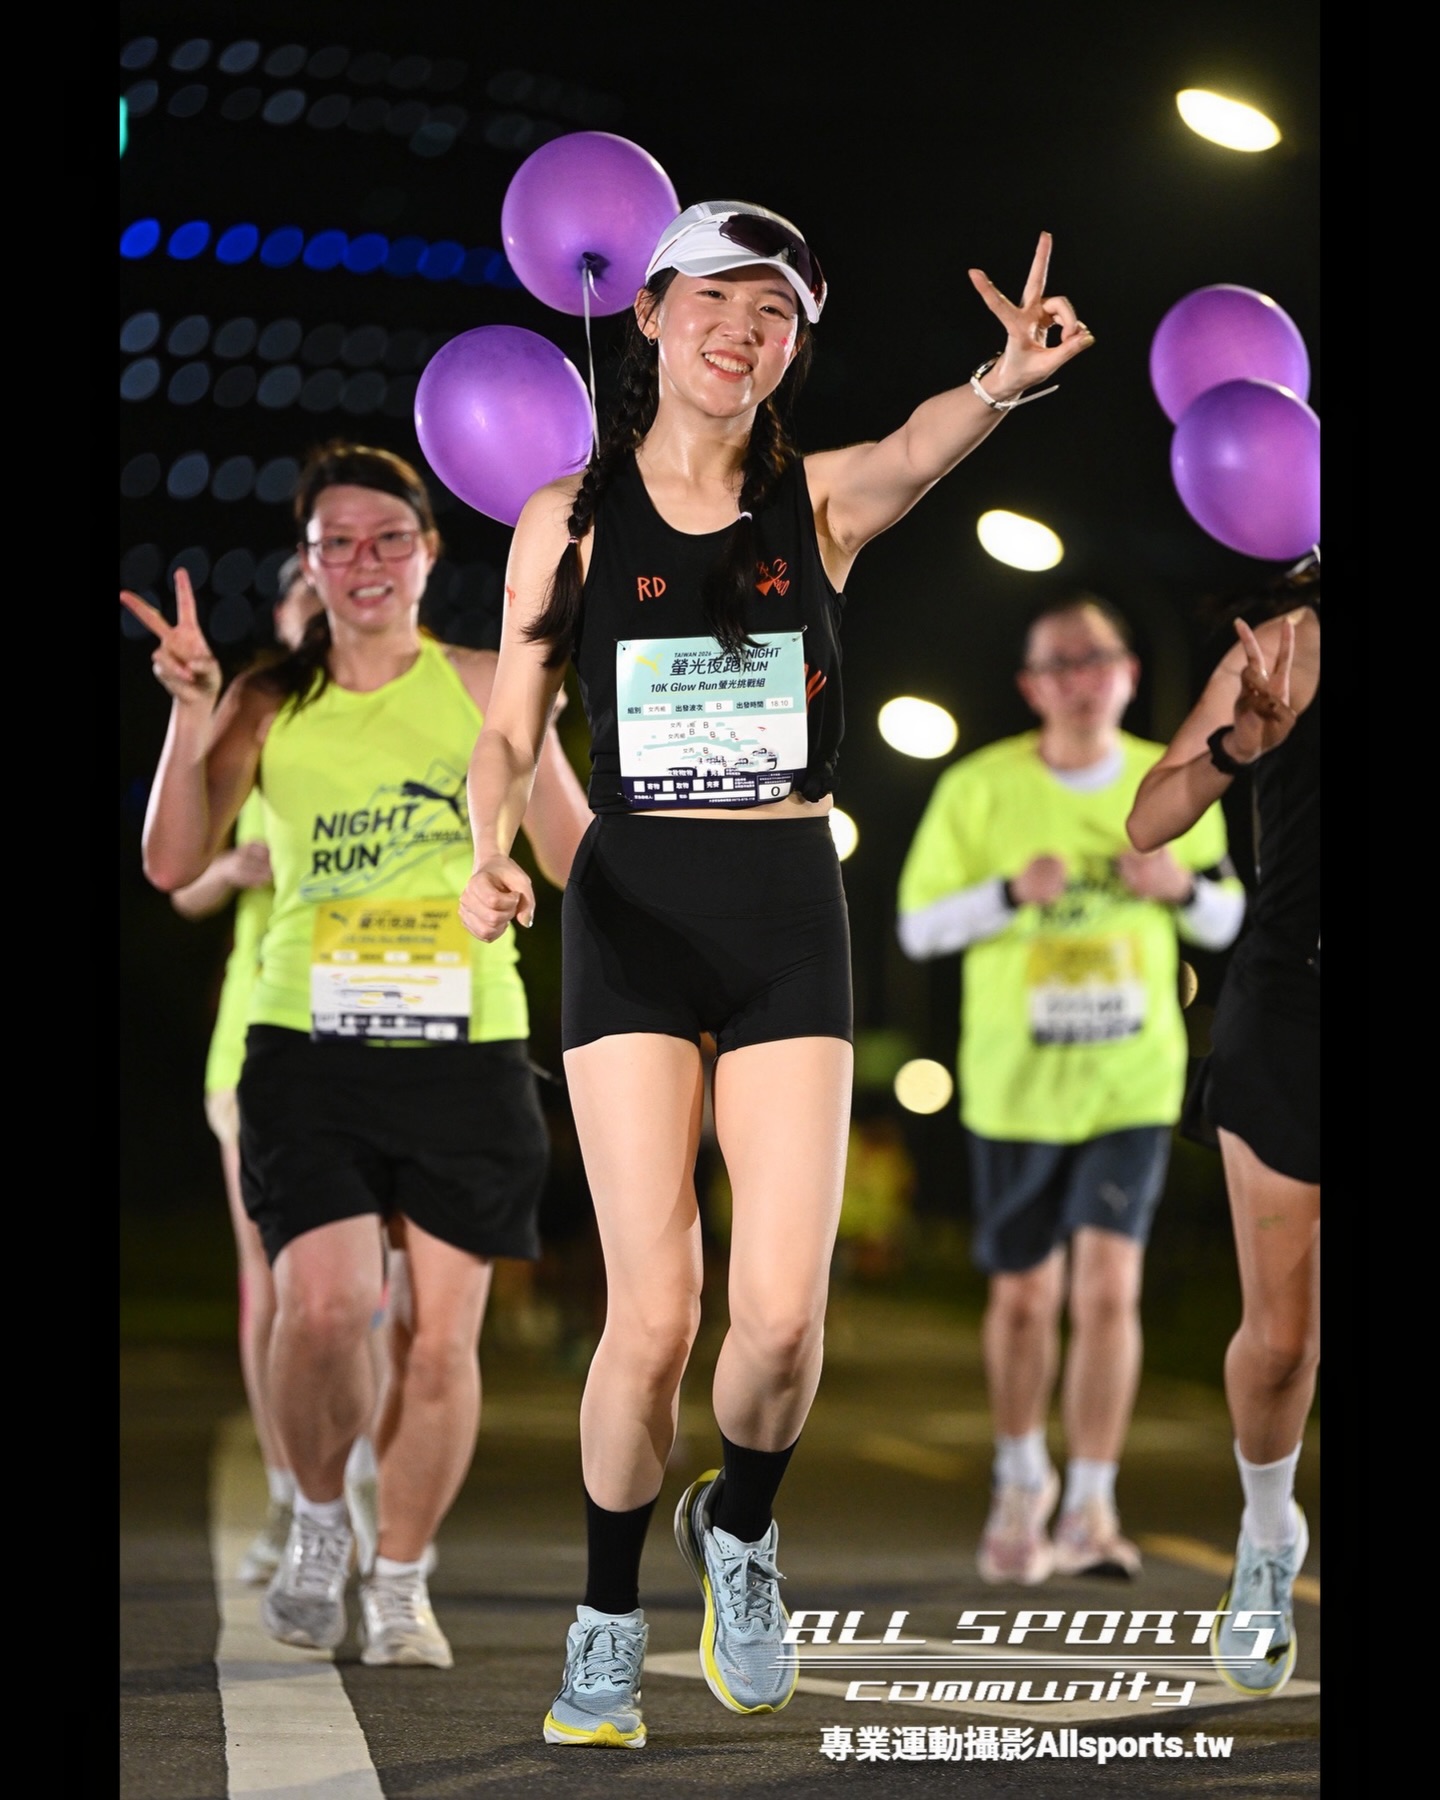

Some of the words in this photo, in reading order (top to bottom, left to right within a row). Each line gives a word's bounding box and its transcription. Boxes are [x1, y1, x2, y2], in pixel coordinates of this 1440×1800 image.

[637, 576, 667, 601] RD
[745, 647, 782, 659] NIGHT
[669, 657, 741, 677] 螢光夜跑
[743, 661, 768, 673] RUN
[650, 682, 668, 693] 10K
[670, 682, 697, 692] Glow
[675, 704, 704, 713] 出發波次
[715, 702, 722, 711] B
[736, 701, 765, 710] 出發時間
[703, 721, 709, 729] B
[689, 728, 695, 736] B
[730, 731, 737, 739] B
[312, 802, 420, 842] NIGHT
[311, 843, 381, 876] RUN
